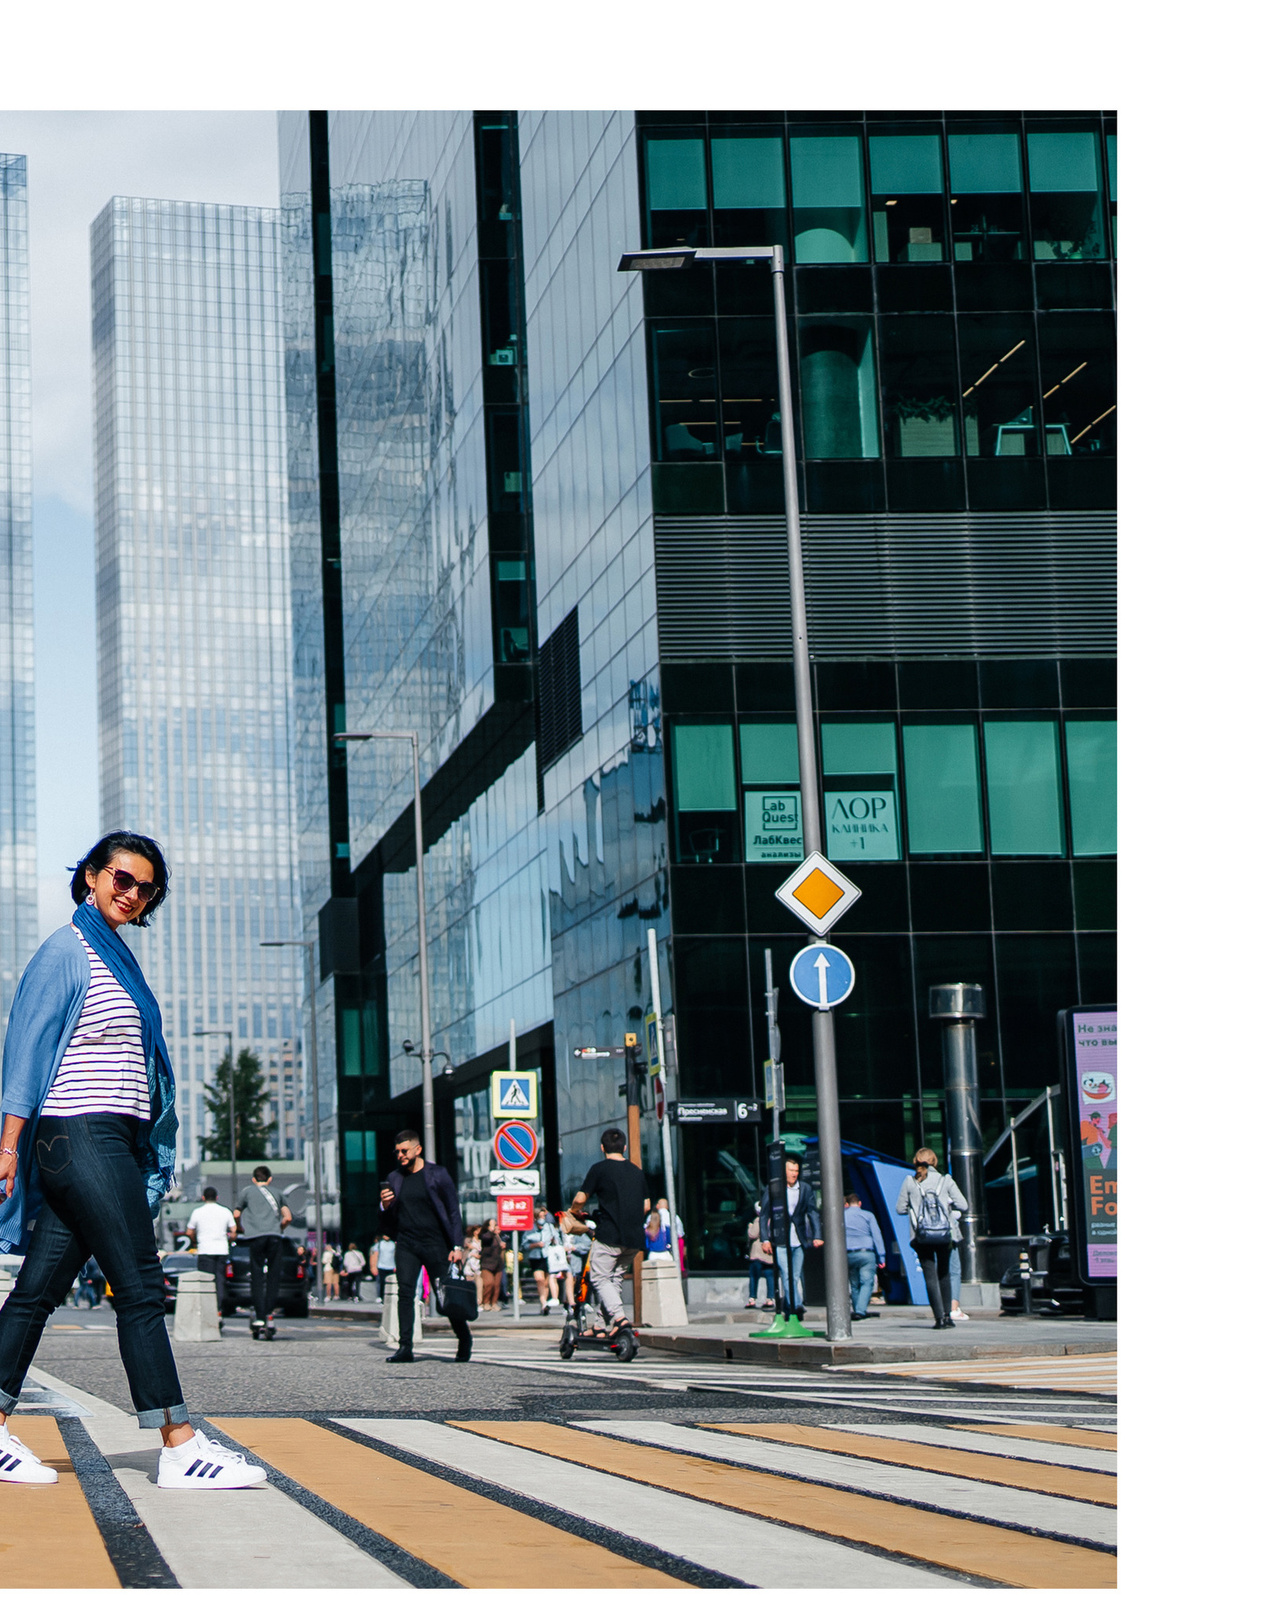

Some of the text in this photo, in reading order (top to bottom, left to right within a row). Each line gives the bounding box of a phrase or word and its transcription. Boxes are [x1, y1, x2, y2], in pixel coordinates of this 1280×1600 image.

[762, 811, 799, 824] Quest
[831, 824, 889, 834] КЛИНИКА
[753, 835, 803, 845] ЛабКвес
[1078, 1024, 1094, 1034] Не
